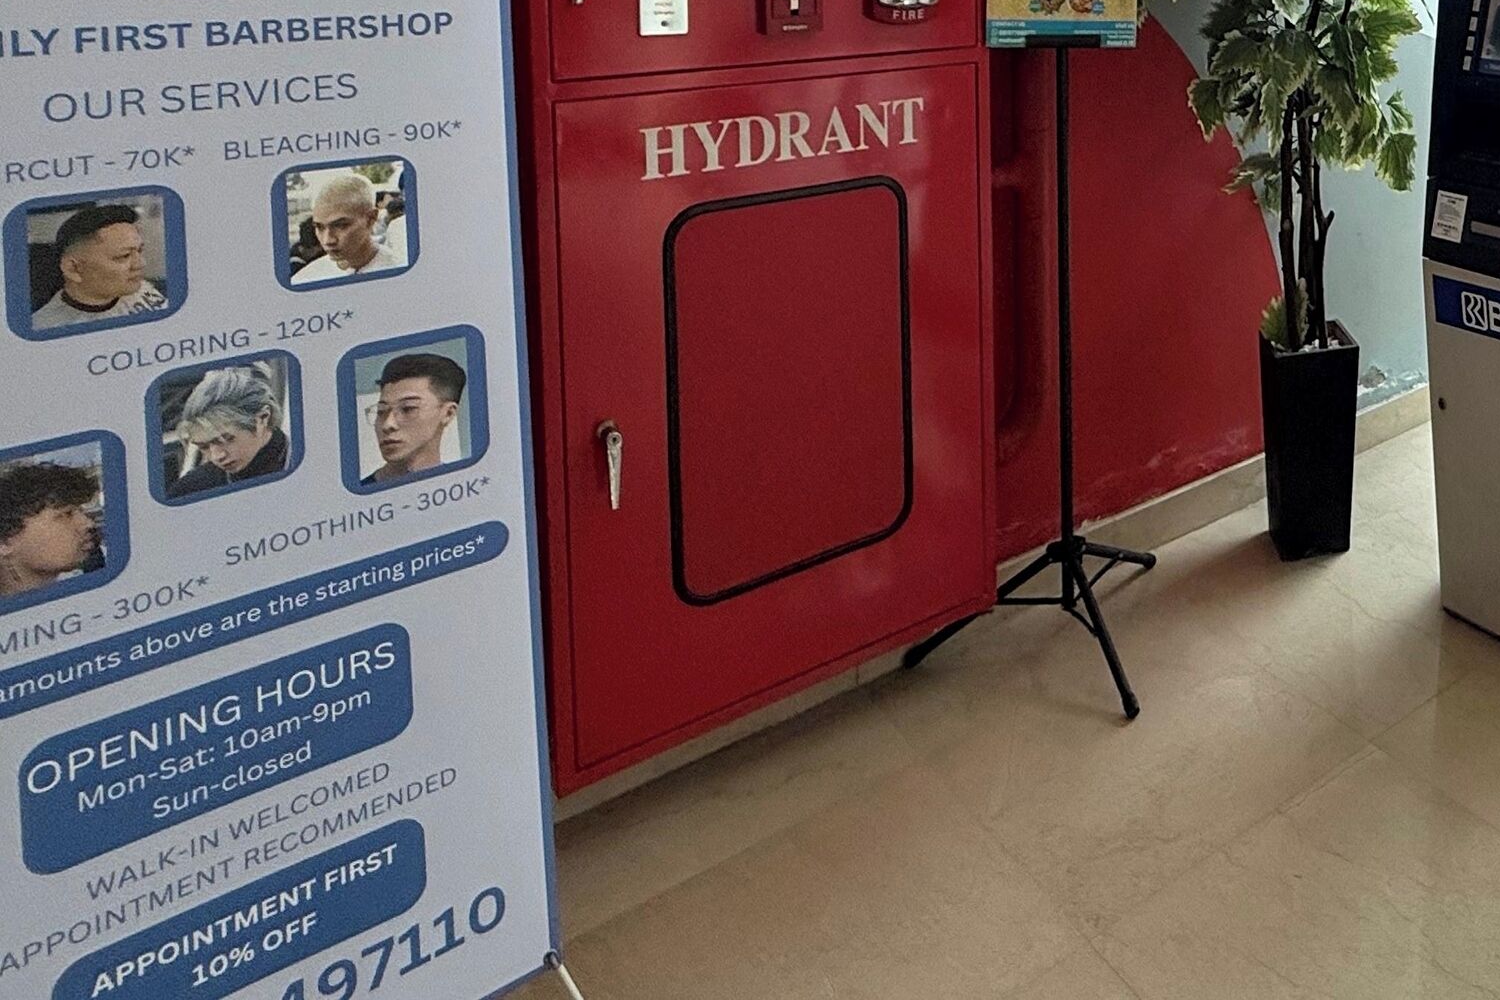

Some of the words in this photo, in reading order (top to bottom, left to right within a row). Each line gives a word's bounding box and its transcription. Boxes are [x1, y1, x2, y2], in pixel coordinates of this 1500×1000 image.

[75, 23, 192, 53] FIRST
[206, 13, 453, 47] BARBERSHOP
[893, 9, 925, 20] FIRE
[44, 88, 146, 122] OUR
[161, 72, 358, 114] SERVICES
[5, 155, 94, 183] RCUT
[224, 127, 381, 161] BLEACHING
[640, 98, 924, 180] HYDRANT
[88, 328, 250, 376] COLORING
[225, 502, 395, 567] SMOOTHING
[129, 621, 214, 662] above
[220, 606, 262, 631] are
[267, 589, 310, 616] the
[315, 560, 405, 600] starting
[26, 695, 242, 794] OPENING
[256, 641, 396, 712] HOURS
[77, 744, 216, 813] Mon-Sat:
[223, 689, 372, 757] 10am-9pm
[152, 741, 312, 819] Sun-closed
[86, 831, 220, 899] WALK-IN
[227, 762, 390, 840] WELCOMED
[0, 858, 234, 976] APPOINTMENT
[244, 767, 457, 875] RECOMMENDED
[90, 880, 316, 998] APPOINTMENT
[323, 843, 398, 897] FIRST
[192, 942, 255, 987] 10%
[262, 911, 320, 953] OFF
